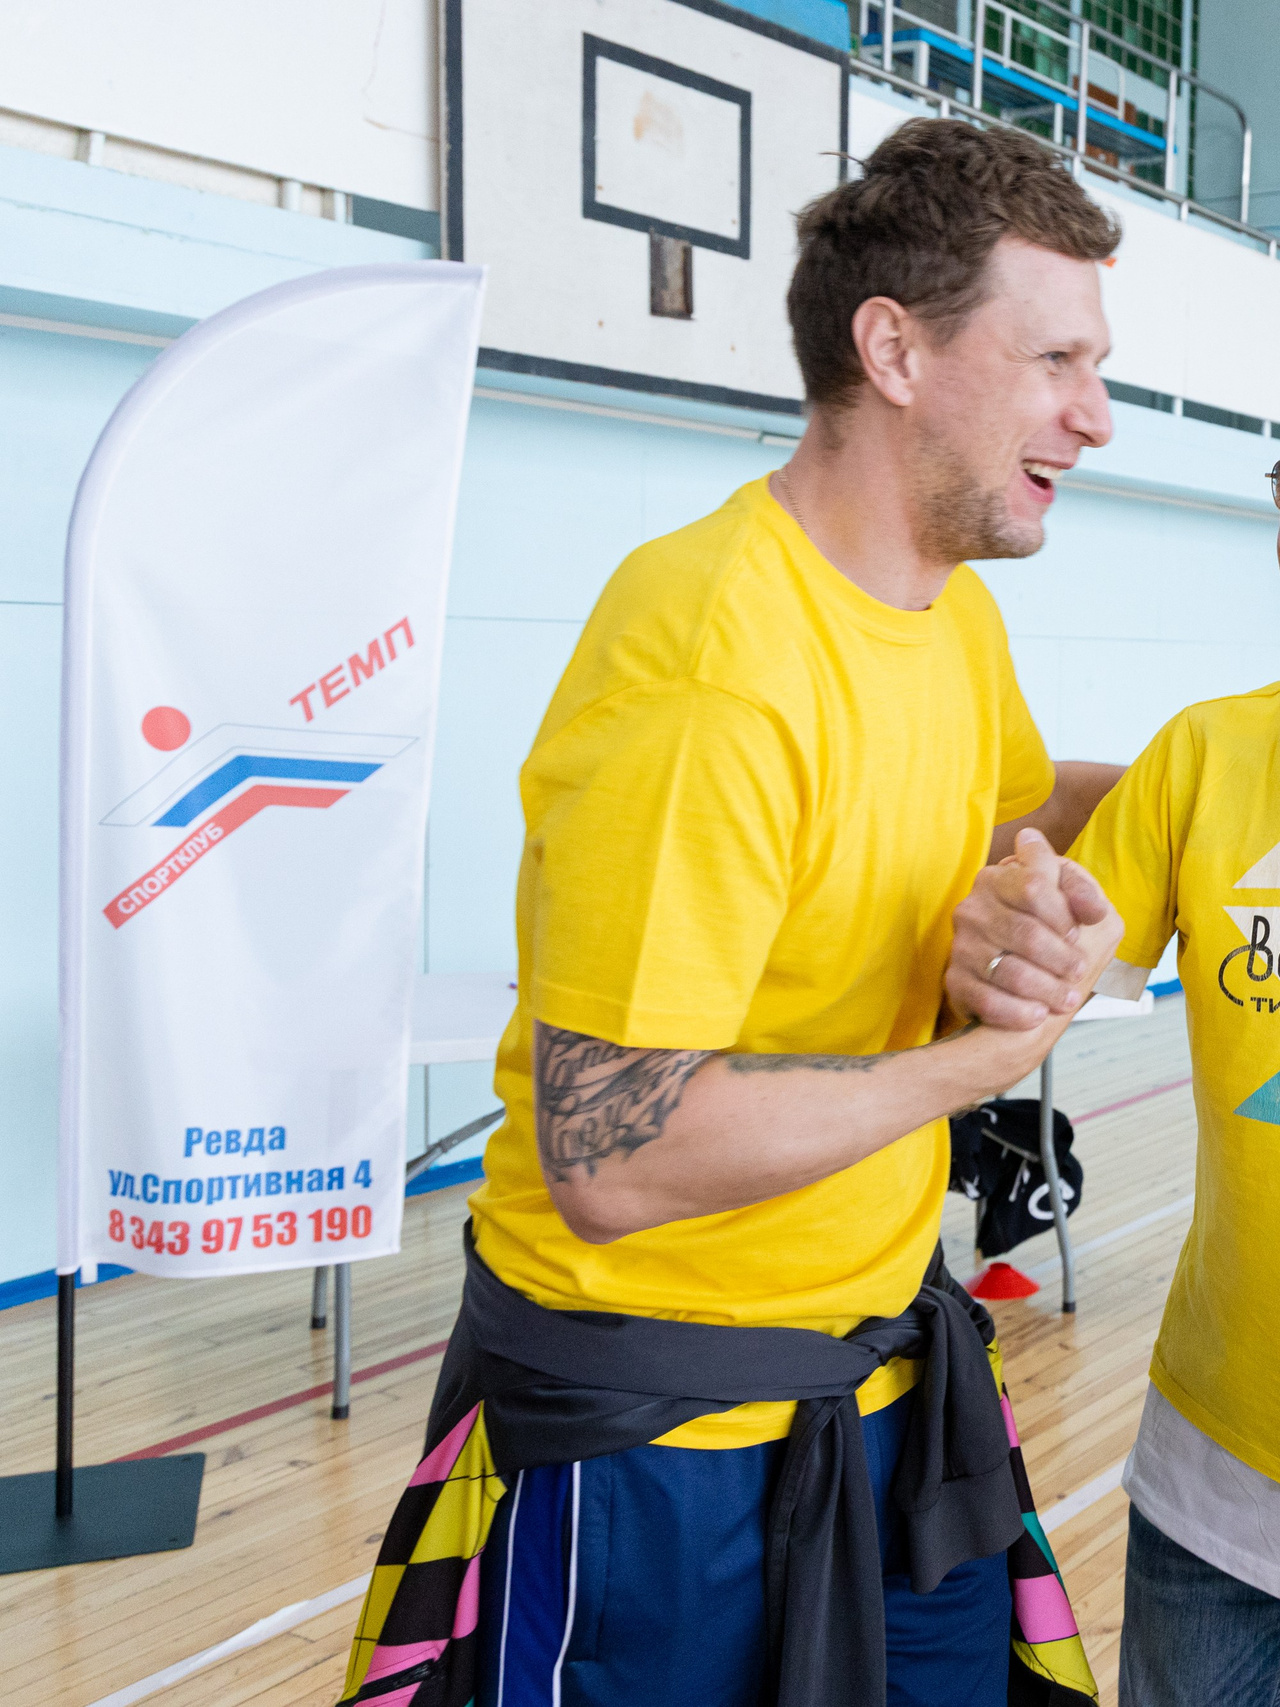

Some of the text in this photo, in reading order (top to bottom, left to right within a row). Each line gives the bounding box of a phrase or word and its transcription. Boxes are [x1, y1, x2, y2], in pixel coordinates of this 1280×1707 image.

[289, 616, 416, 723] ТЕМП
[117, 821, 225, 915] СПОРТКЛУБ
[183, 1125, 287, 1158] Ревда
[353, 1158, 373, 1189] 4
[200, 1216, 244, 1254] 97
[252, 1210, 298, 1248] 53
[307, 1204, 373, 1242] 190
